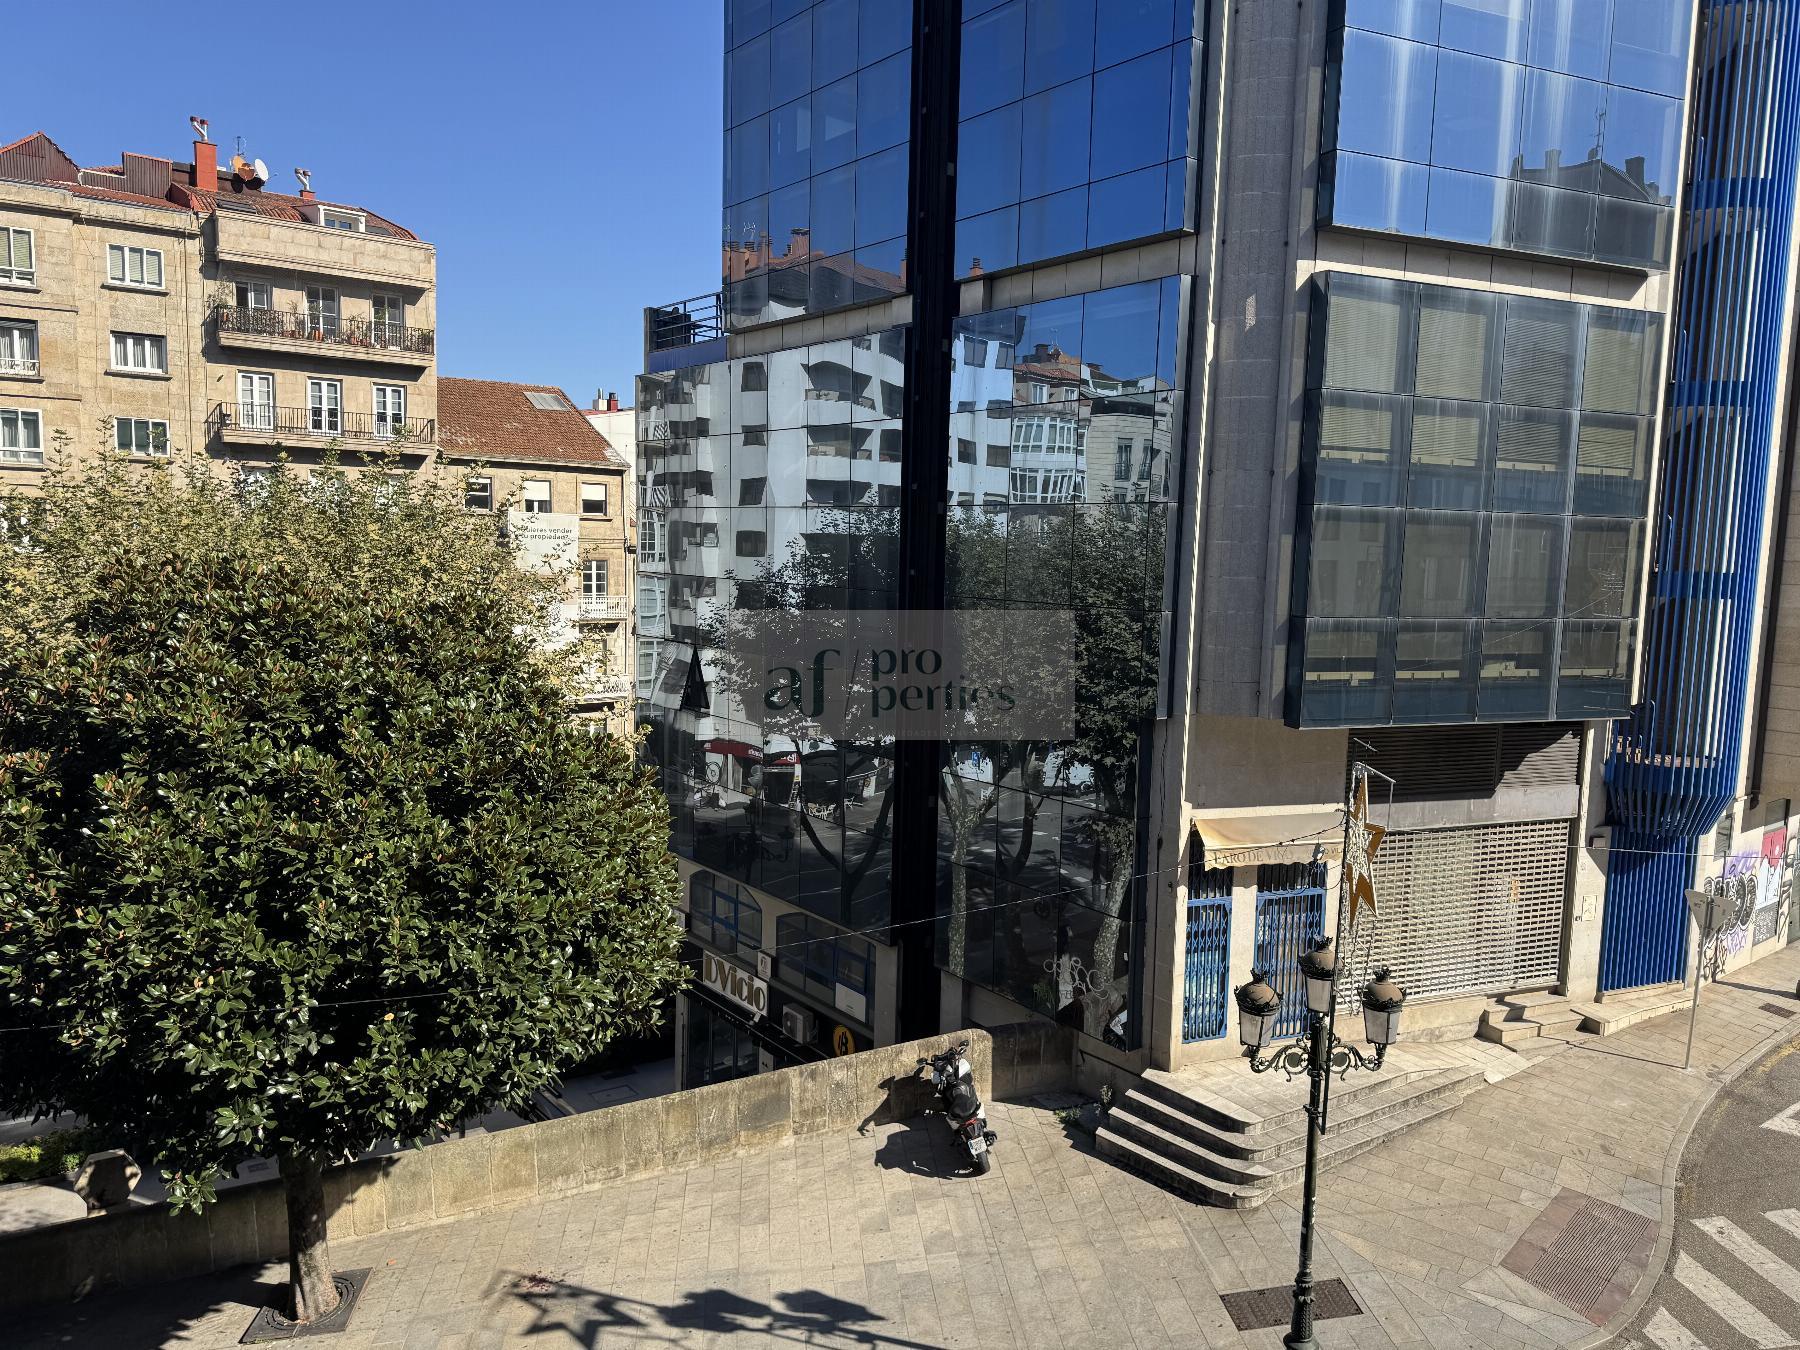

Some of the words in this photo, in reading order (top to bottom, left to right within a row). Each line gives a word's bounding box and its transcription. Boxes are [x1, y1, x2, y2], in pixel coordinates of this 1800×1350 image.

[1213, 851, 1245, 864] FARO
[1248, 850, 1264, 862] DE
[704, 956, 766, 1012] DVicio
